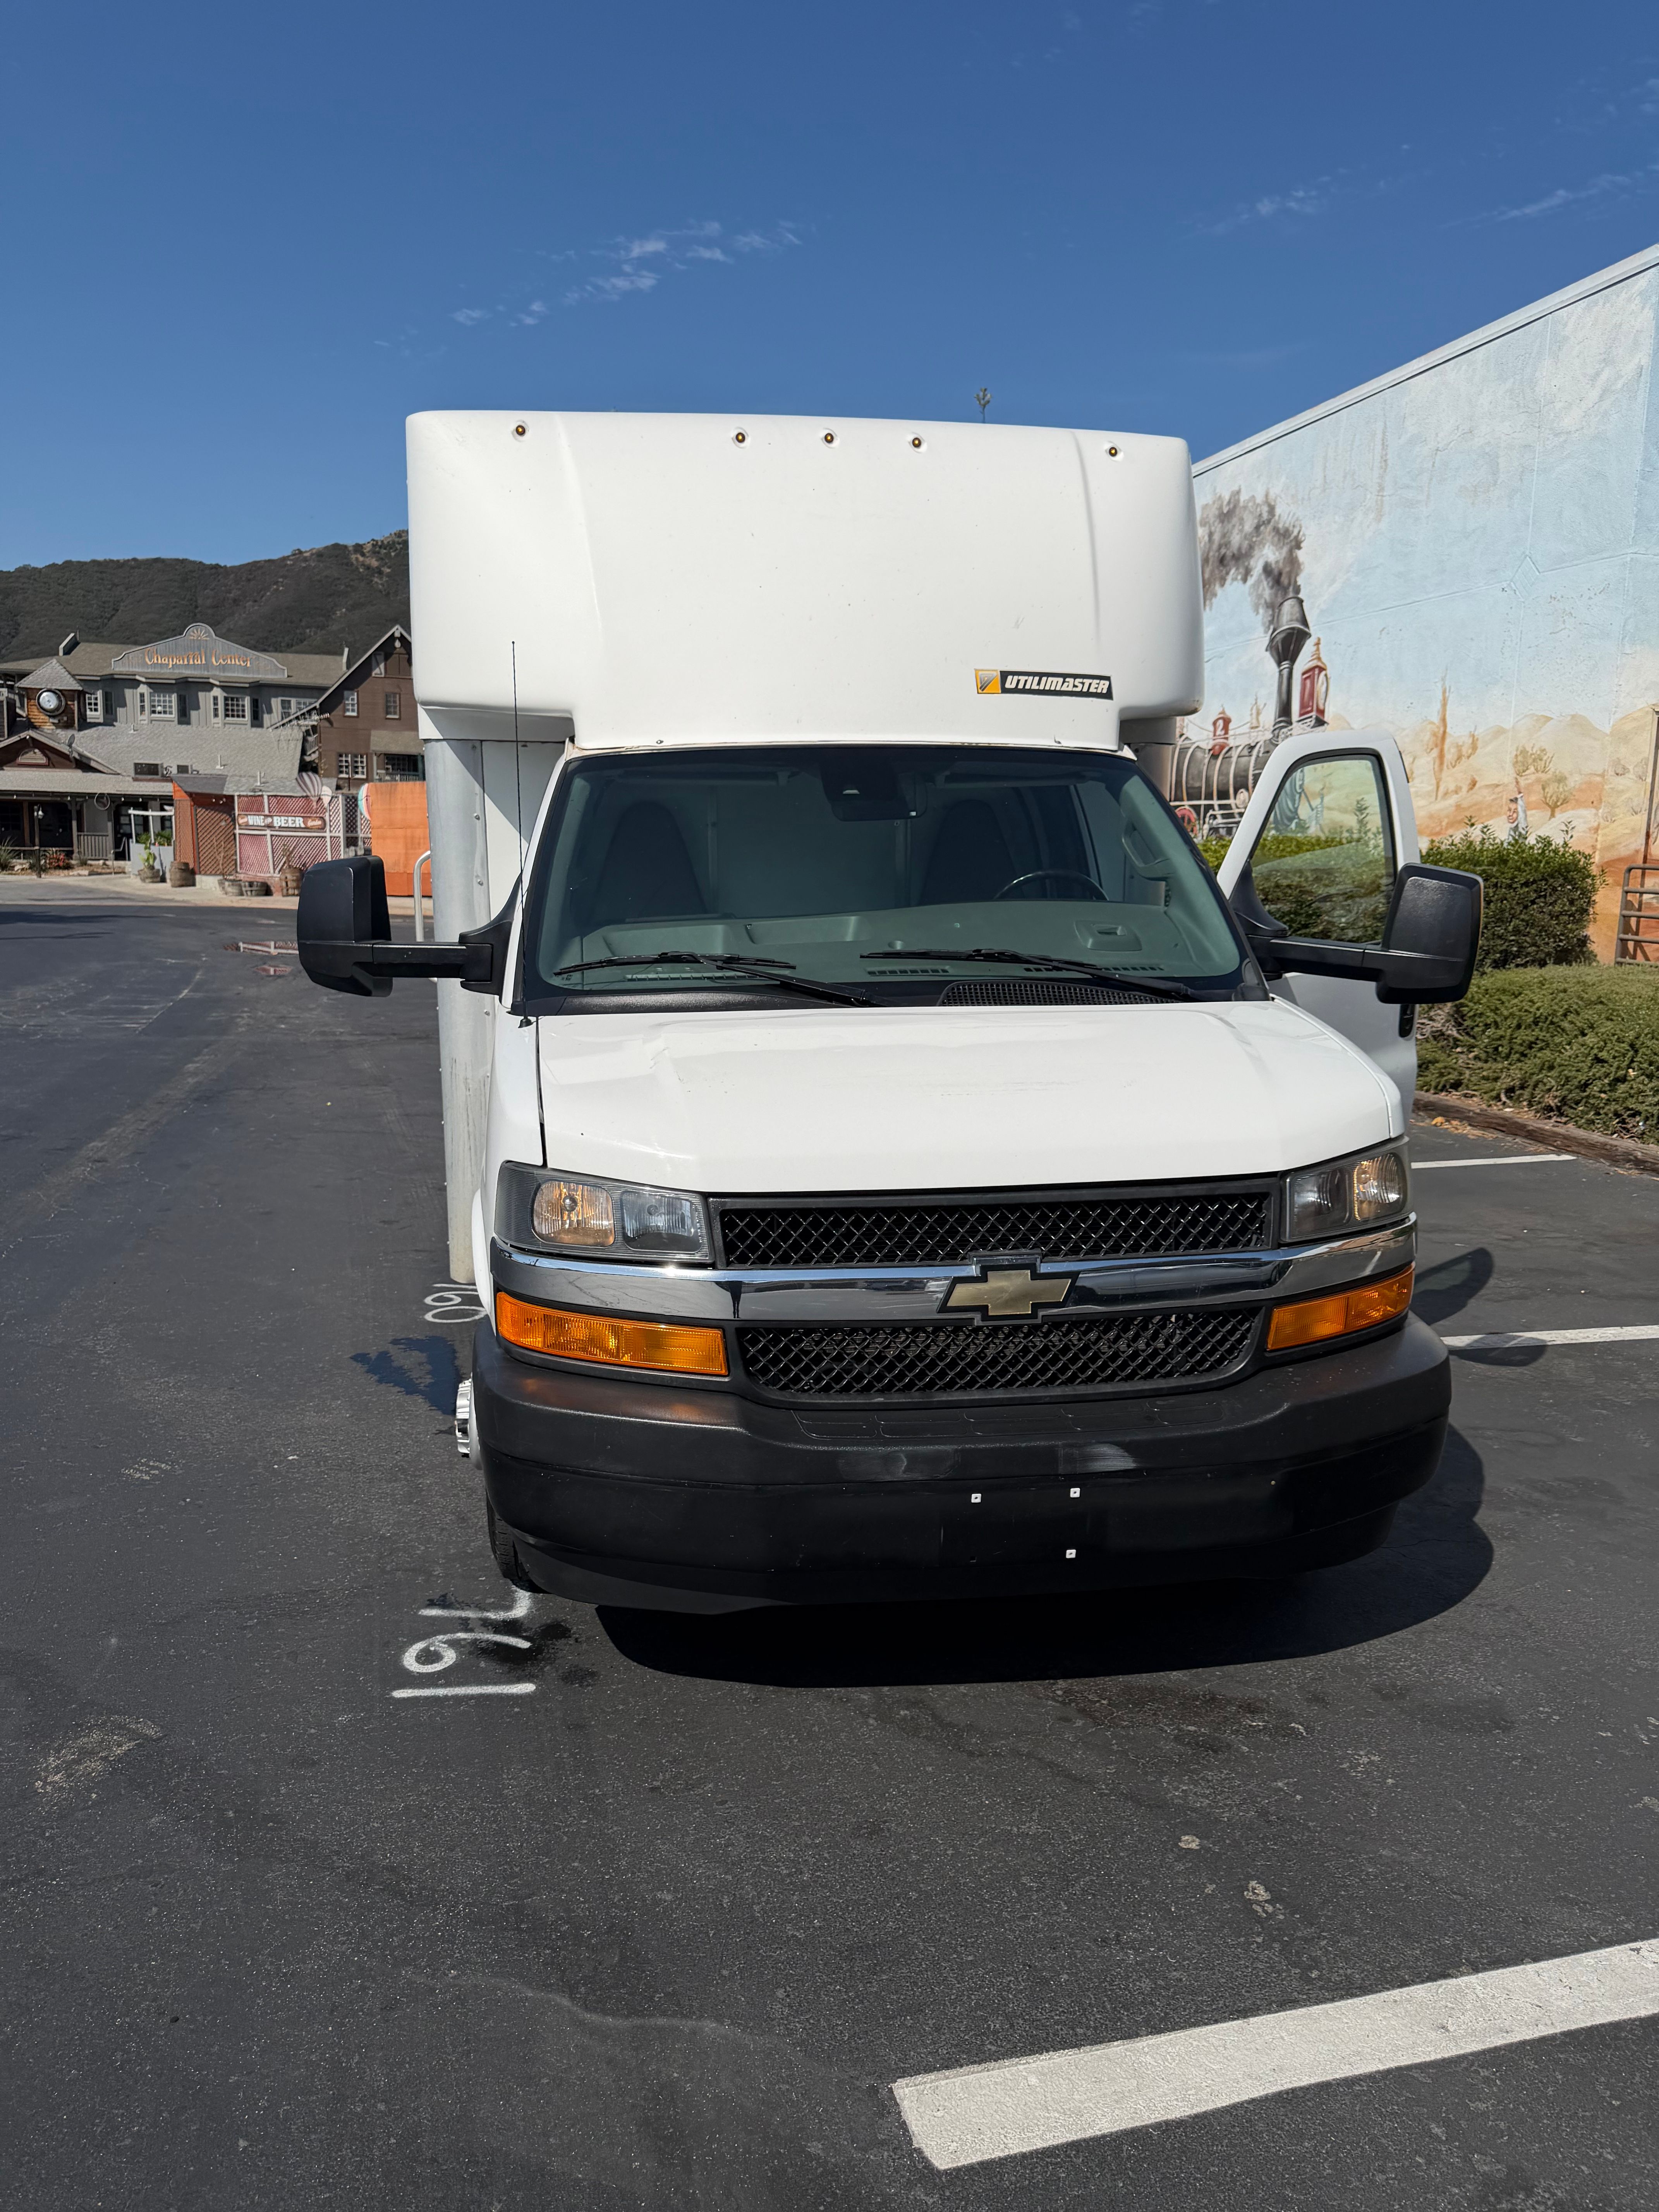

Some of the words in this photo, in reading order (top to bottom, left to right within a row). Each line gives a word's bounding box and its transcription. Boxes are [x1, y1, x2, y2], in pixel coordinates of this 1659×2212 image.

[144, 648, 206, 668] Chaparral
[212, 650, 252, 667] Center
[1005, 675, 1109, 694] UTILIMASTER
[1215, 719, 1225, 736] 2
[247, 815, 265, 826] WINE
[273, 816, 305, 828] BEER
